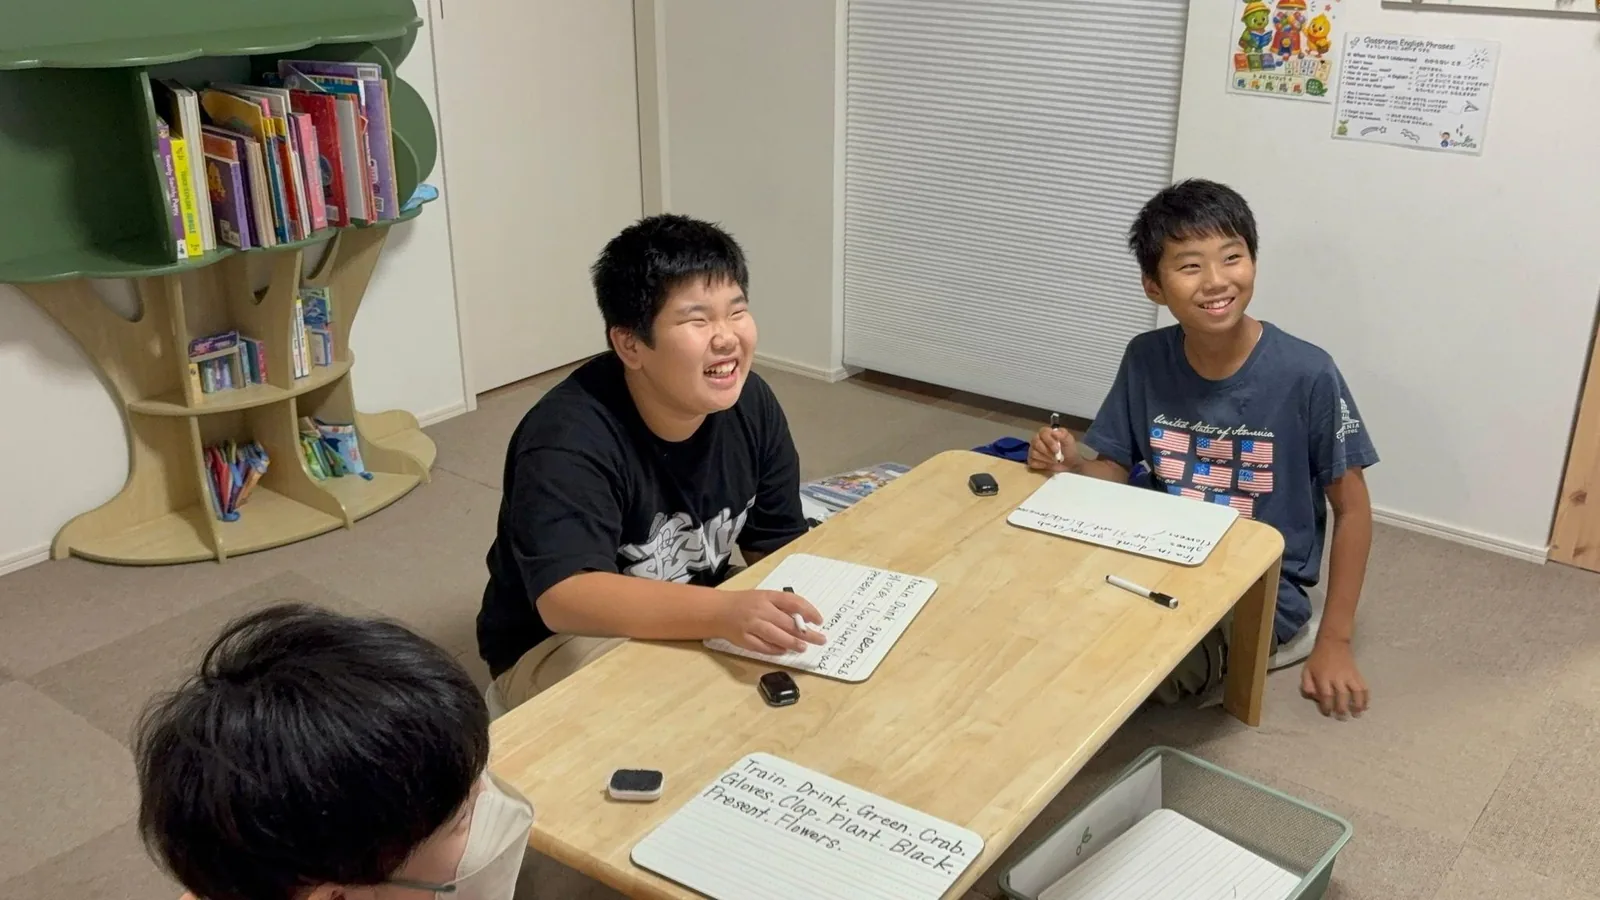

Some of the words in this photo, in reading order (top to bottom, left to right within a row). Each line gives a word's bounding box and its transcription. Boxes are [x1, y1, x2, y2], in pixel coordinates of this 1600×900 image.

[1364, 36, 1398, 45] Classroom
[1400, 38, 1424, 48] English
[1153, 413, 1189, 429] United
[1190, 420, 1219, 435] States
[1217, 427, 1232, 441] of
[1232, 423, 1275, 438] America
[703, 785, 769, 822] Present.
[774, 813, 842, 851] Flowers.
[720, 772, 774, 803] Gloves.
[778, 795, 821, 822] Clap.
[889, 838, 954, 875] Black.
[743, 758, 787, 788] Train.
[796, 781, 849, 812] Drink.
[857, 804, 912, 836] Green.
[919, 828, 965, 857] Crab.
